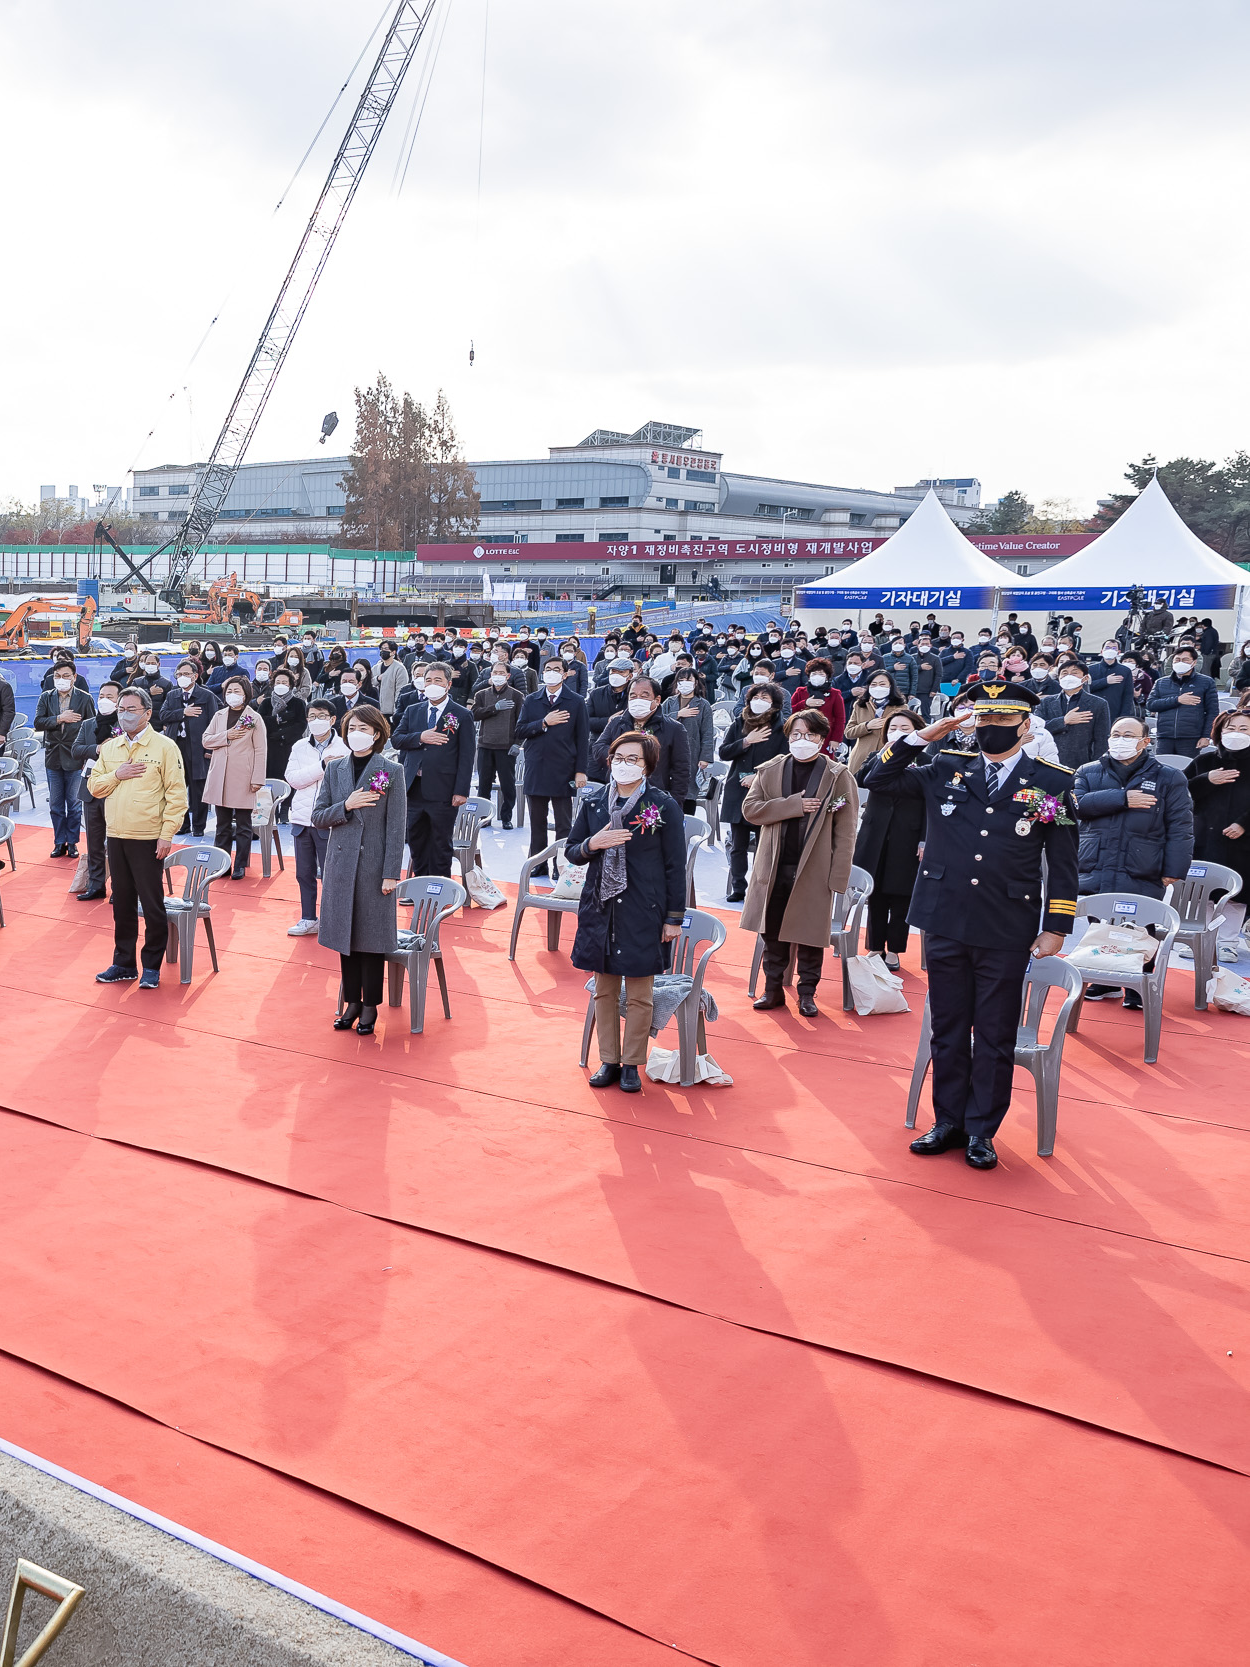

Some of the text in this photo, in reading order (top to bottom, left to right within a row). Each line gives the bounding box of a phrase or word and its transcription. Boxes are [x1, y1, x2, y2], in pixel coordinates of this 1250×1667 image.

[606, 541, 873, 556] 자양1 재정비촉진구역 도시정비형 재개발사업
[999, 541, 1024, 550] Value
[1025, 541, 1061, 550] Creator
[880, 590, 962, 607] 기자대기실
